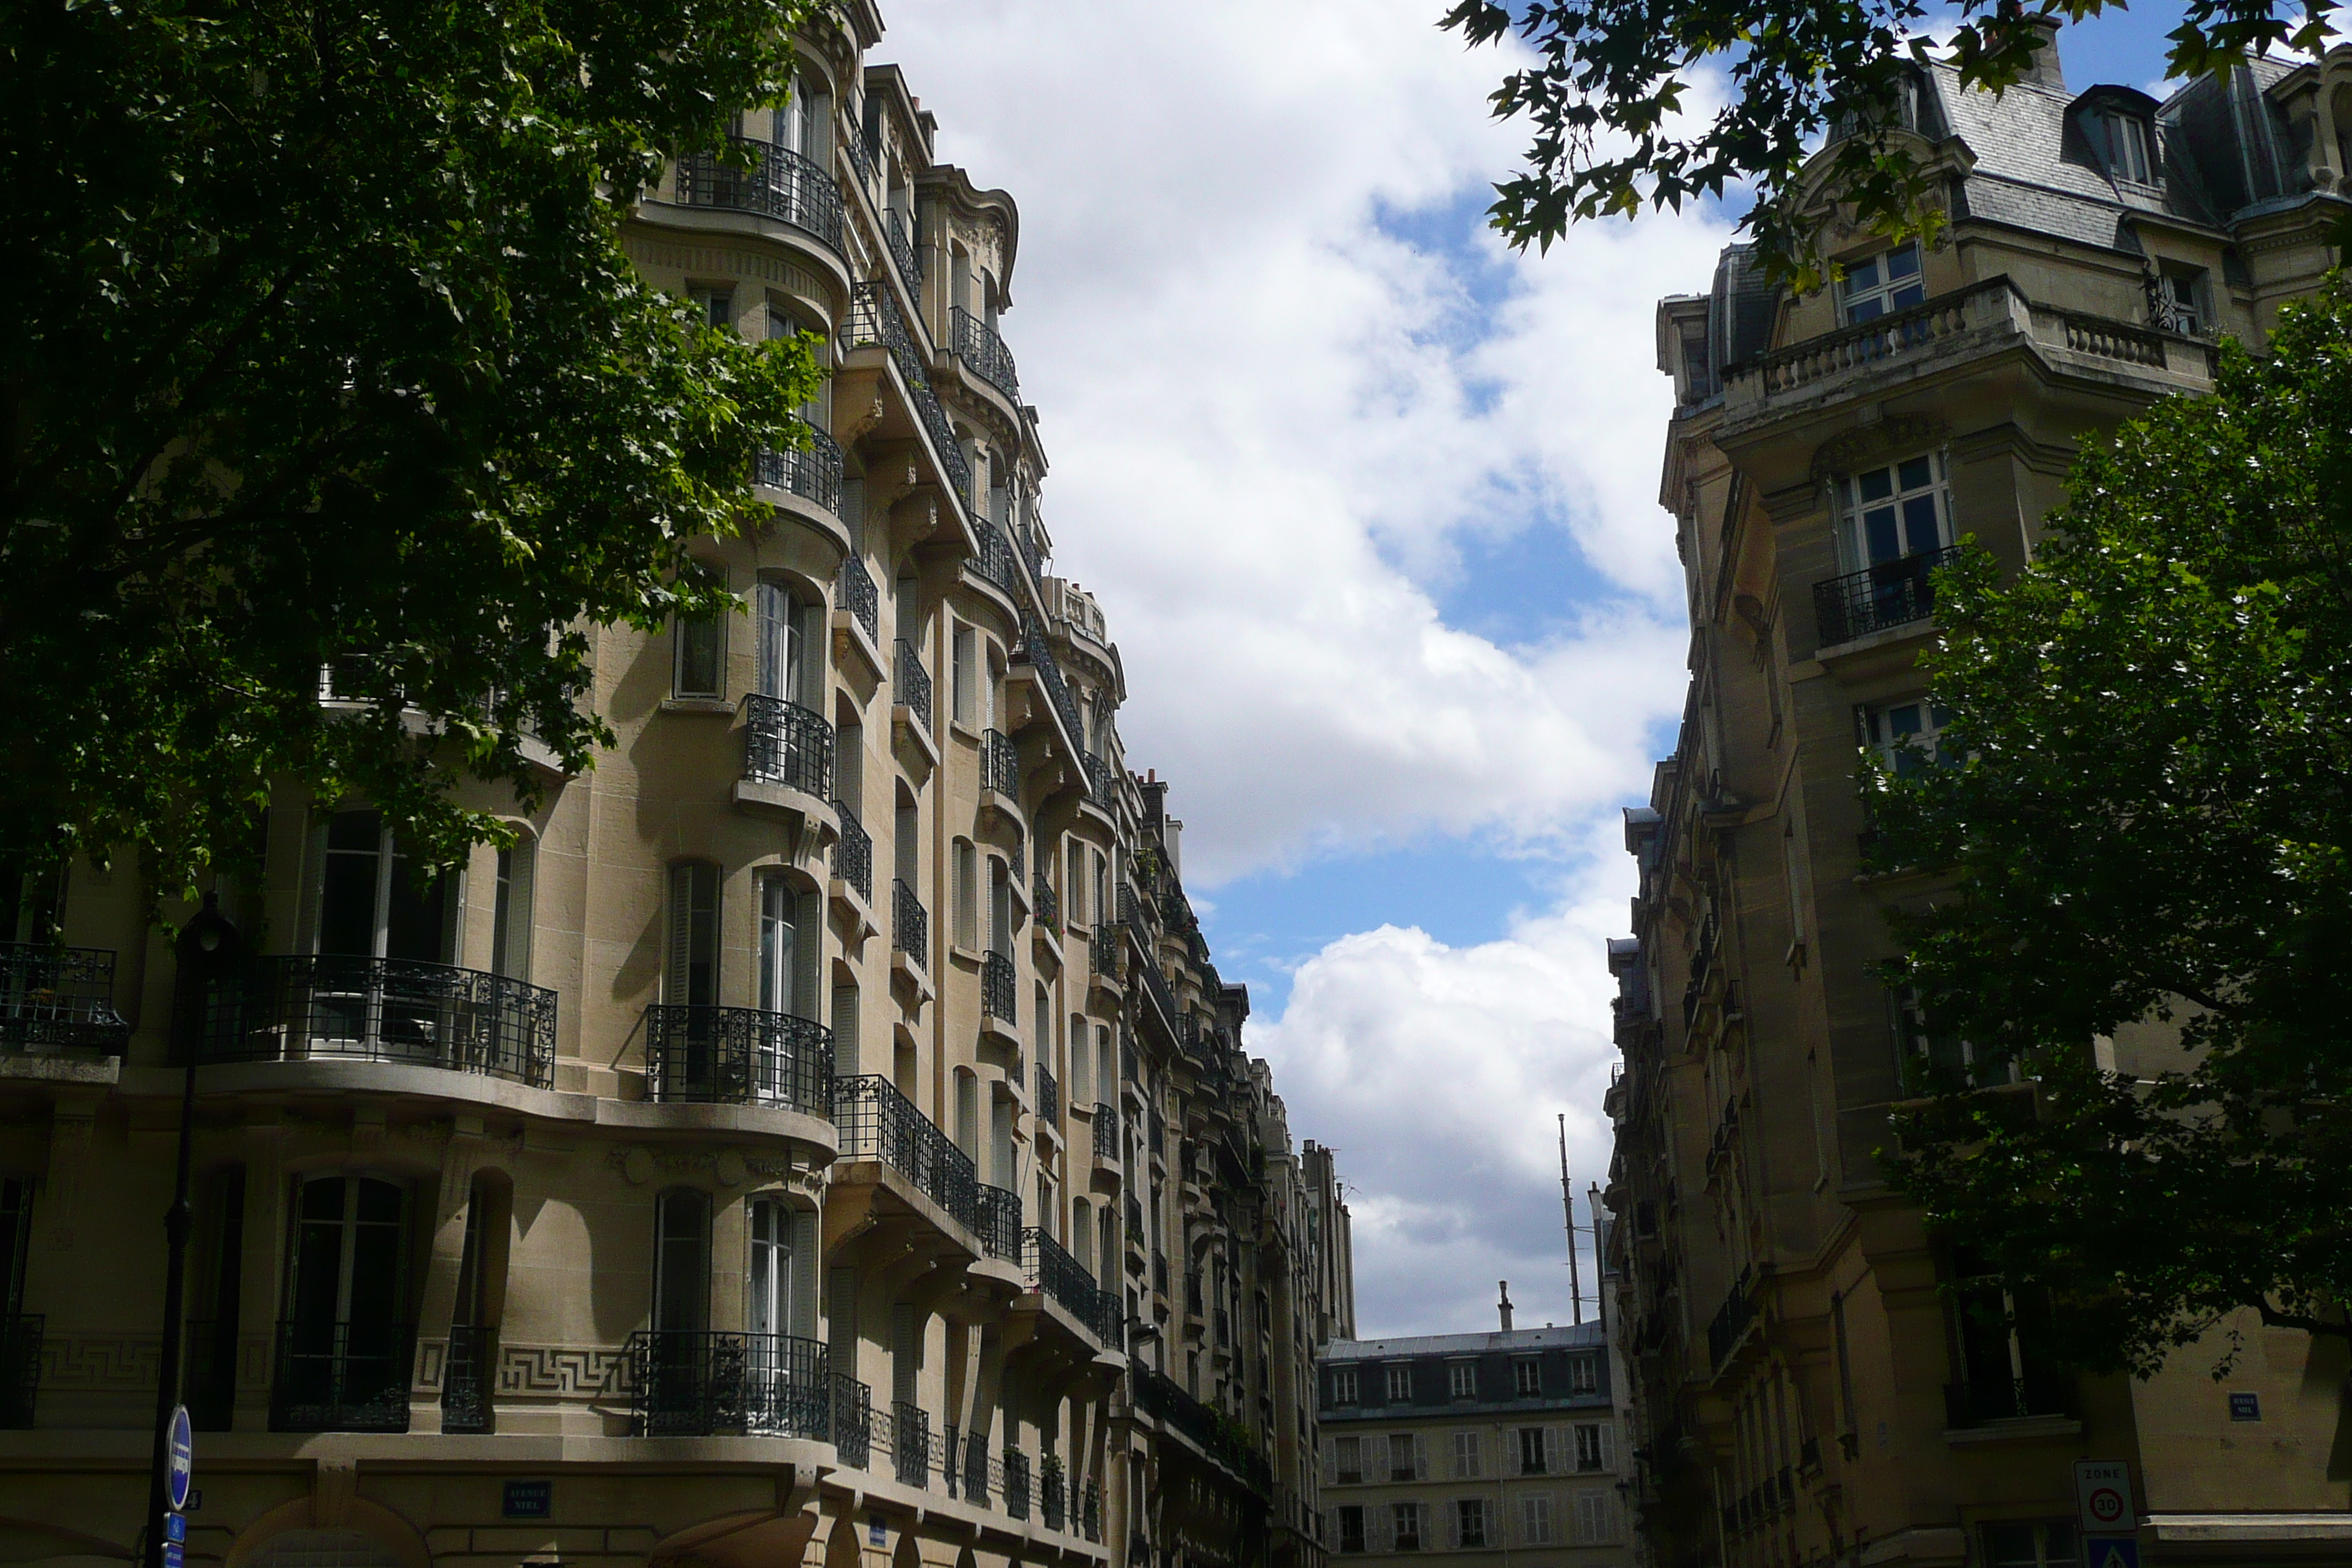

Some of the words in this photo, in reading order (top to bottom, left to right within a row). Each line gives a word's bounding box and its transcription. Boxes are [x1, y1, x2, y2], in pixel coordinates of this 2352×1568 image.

[2085, 1469, 2120, 1479] ZONE
[510, 1489, 547, 1497] AVENUE
[515, 1501, 539, 1509] NIEL
[2097, 1499, 2115, 1510] 30
